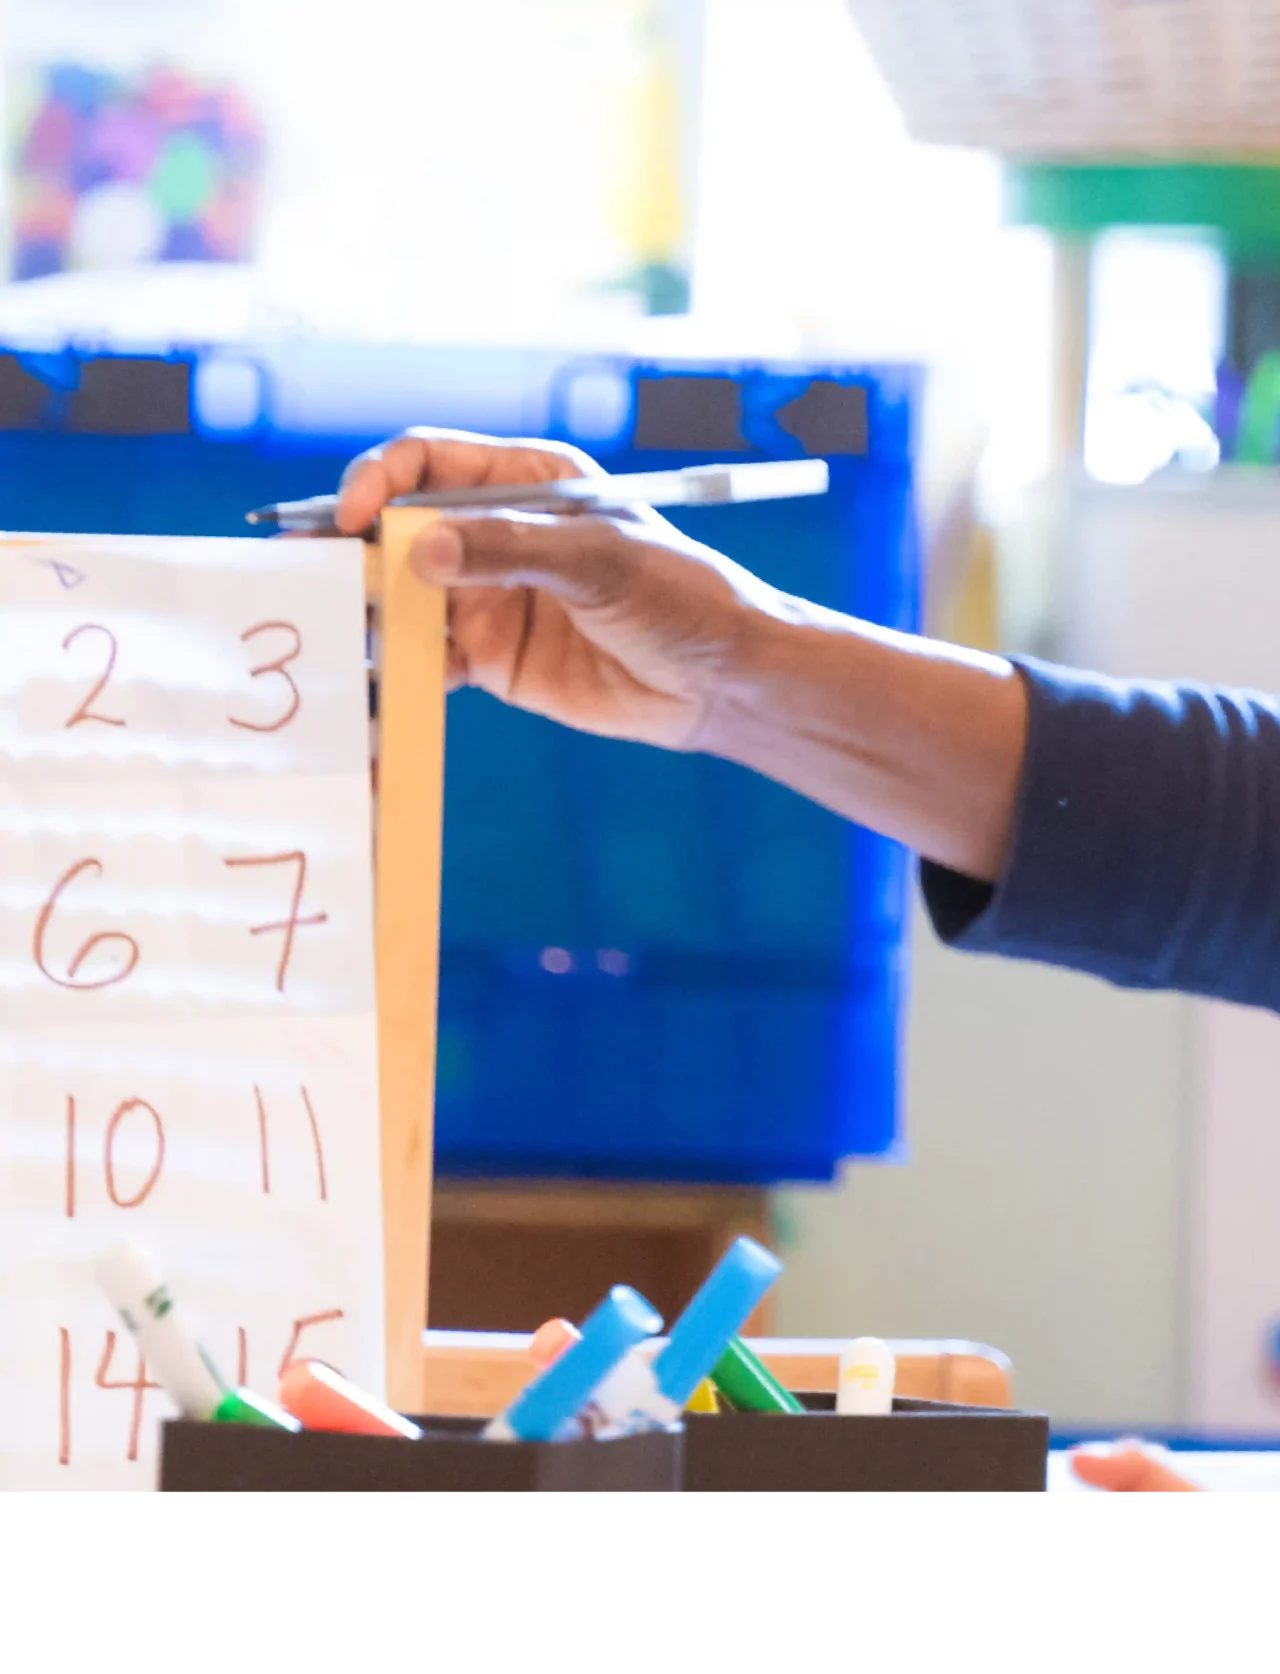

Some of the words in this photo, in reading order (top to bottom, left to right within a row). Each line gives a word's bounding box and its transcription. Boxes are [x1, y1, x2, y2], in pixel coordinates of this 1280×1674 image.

[62, 623, 127, 729] 2
[227, 620, 303, 733] 3
[32, 857, 140, 991] 6
[222, 850, 329, 992] 7
[65, 1093, 166, 1219] 10
[252, 1083, 328, 1202] 11
[57, 1325, 164, 1466] 14
